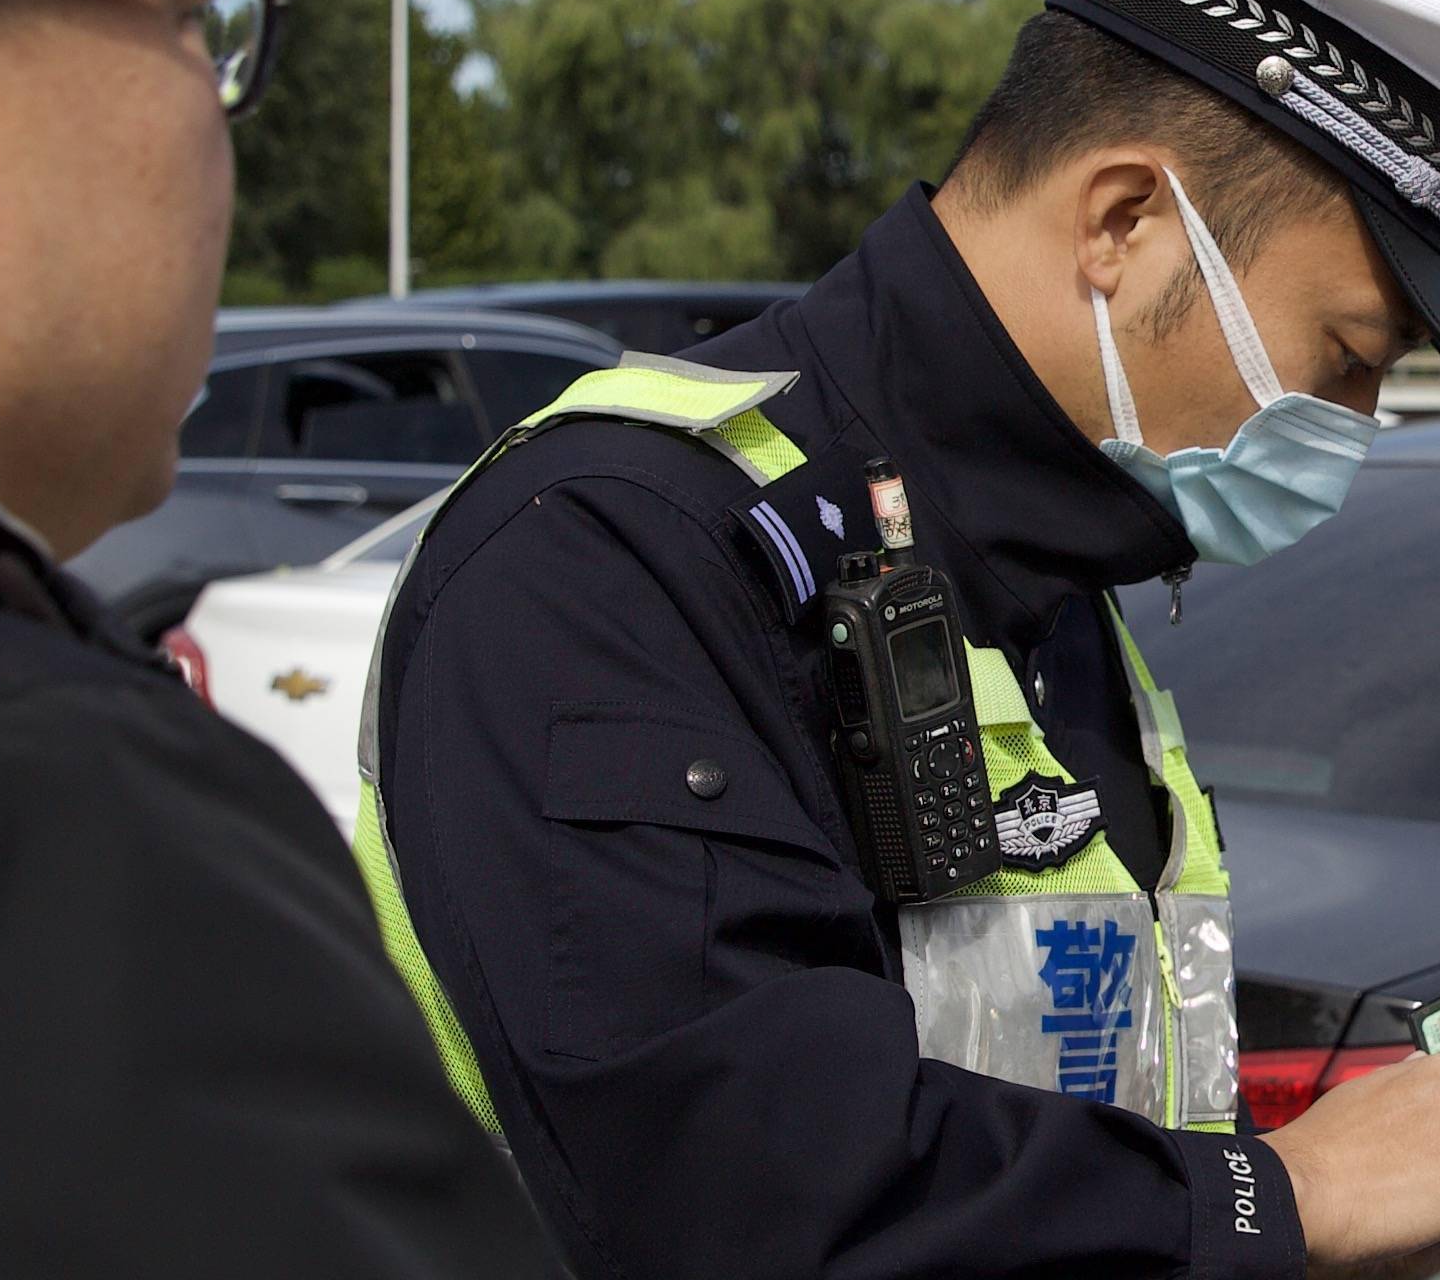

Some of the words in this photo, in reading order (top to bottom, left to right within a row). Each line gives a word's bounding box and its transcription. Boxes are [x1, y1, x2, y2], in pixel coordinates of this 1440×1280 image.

[899, 593, 943, 614] MOTOROLA
[1023, 794, 1052, 816] 北京
[1024, 814, 1058, 830] POLICE
[1222, 1147, 1262, 1235] POLICE
